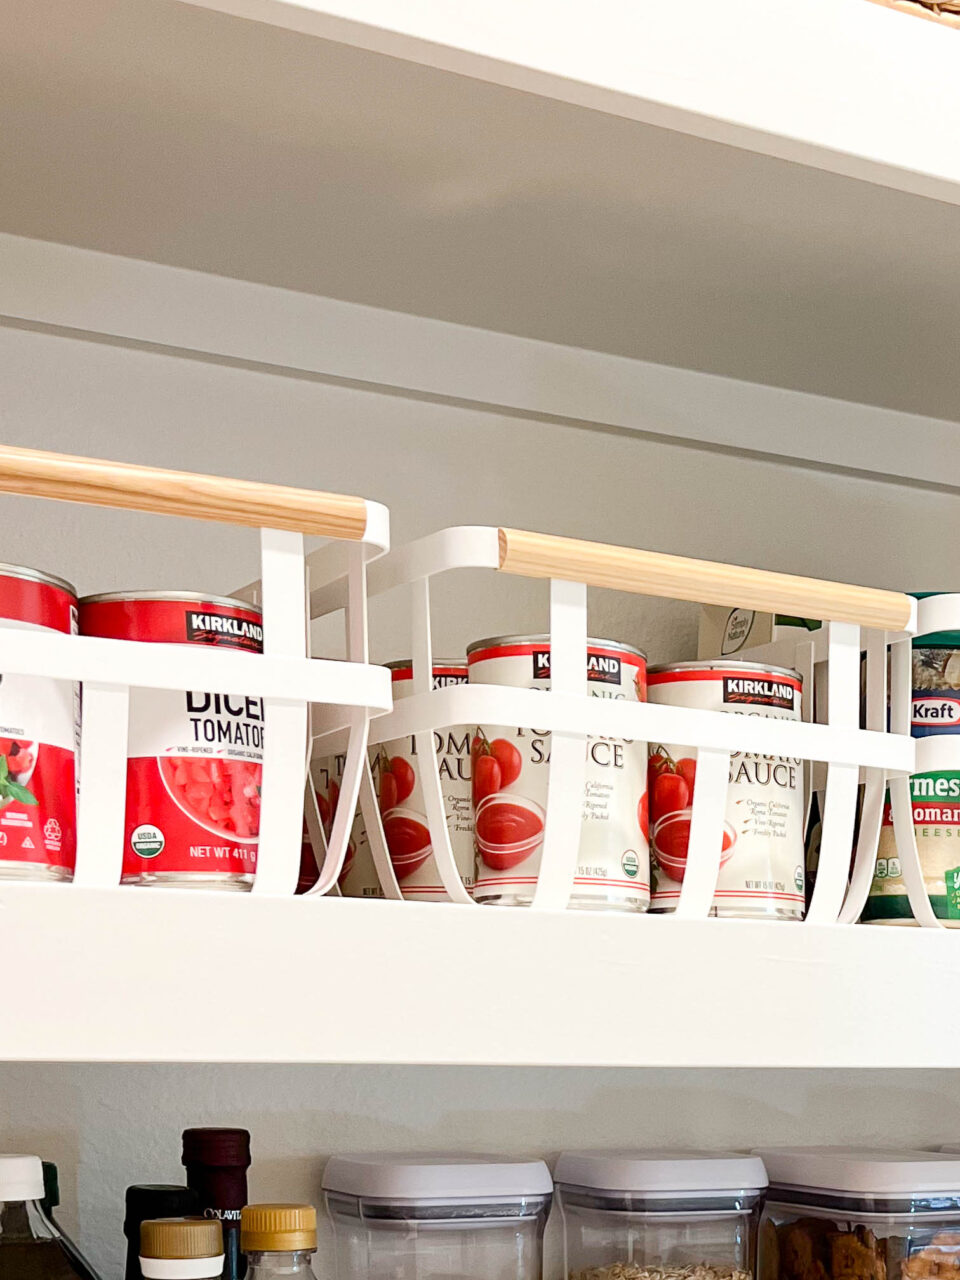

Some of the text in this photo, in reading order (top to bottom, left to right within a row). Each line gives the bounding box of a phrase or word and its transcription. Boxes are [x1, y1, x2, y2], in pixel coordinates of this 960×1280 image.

[191, 614, 263, 641] KIRKLAND
[727, 679, 793, 700] KIRKLAND
[186, 691, 264, 722] DICE
[913, 703, 954, 719] Kraft
[137, 832, 157, 840] USDA
[189, 845, 211, 858] NET
[213, 846, 231, 859] WT
[232, 847, 248, 860] 411
